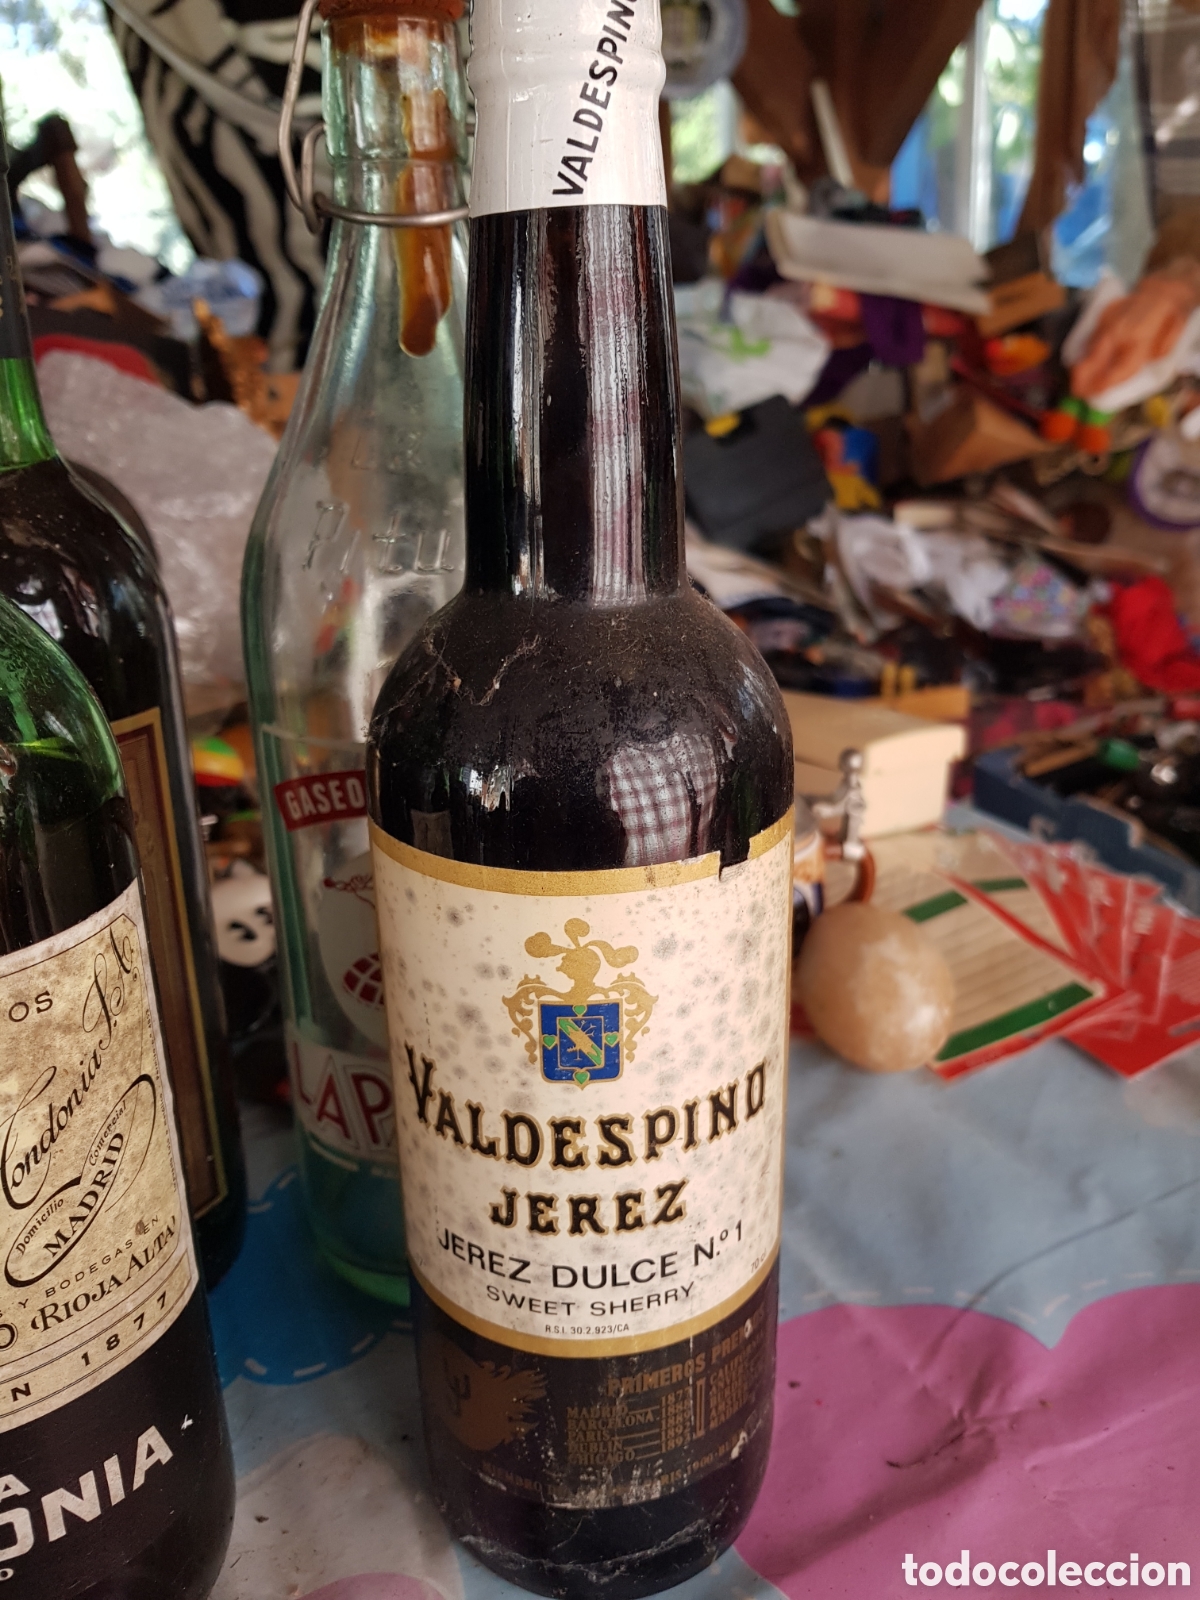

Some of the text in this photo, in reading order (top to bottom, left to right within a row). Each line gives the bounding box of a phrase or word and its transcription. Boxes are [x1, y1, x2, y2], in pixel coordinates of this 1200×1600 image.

[552, 0, 638, 195] VALDESPIN
[404, 1042, 768, 1170] VALDESPINO
[16, 1101, 127, 1256] Domicilio Comercial
[43, 1132, 125, 1259] MADRID
[488, 1178, 689, 1237] JEREZ
[45, 1239, 134, 1299] BODEGAS
[437, 1227, 531, 1284] JEREZ
[552, 1251, 679, 1289] DULCE
[486, 1281, 695, 1316] SWEET SHERRY
[608, 1352, 706, 1397] PRIMEROS
[567, 1402, 629, 1419] MADRID
[567, 1408, 655, 1430] BARCELONA
[568, 1449, 636, 1465] CHICAGO
